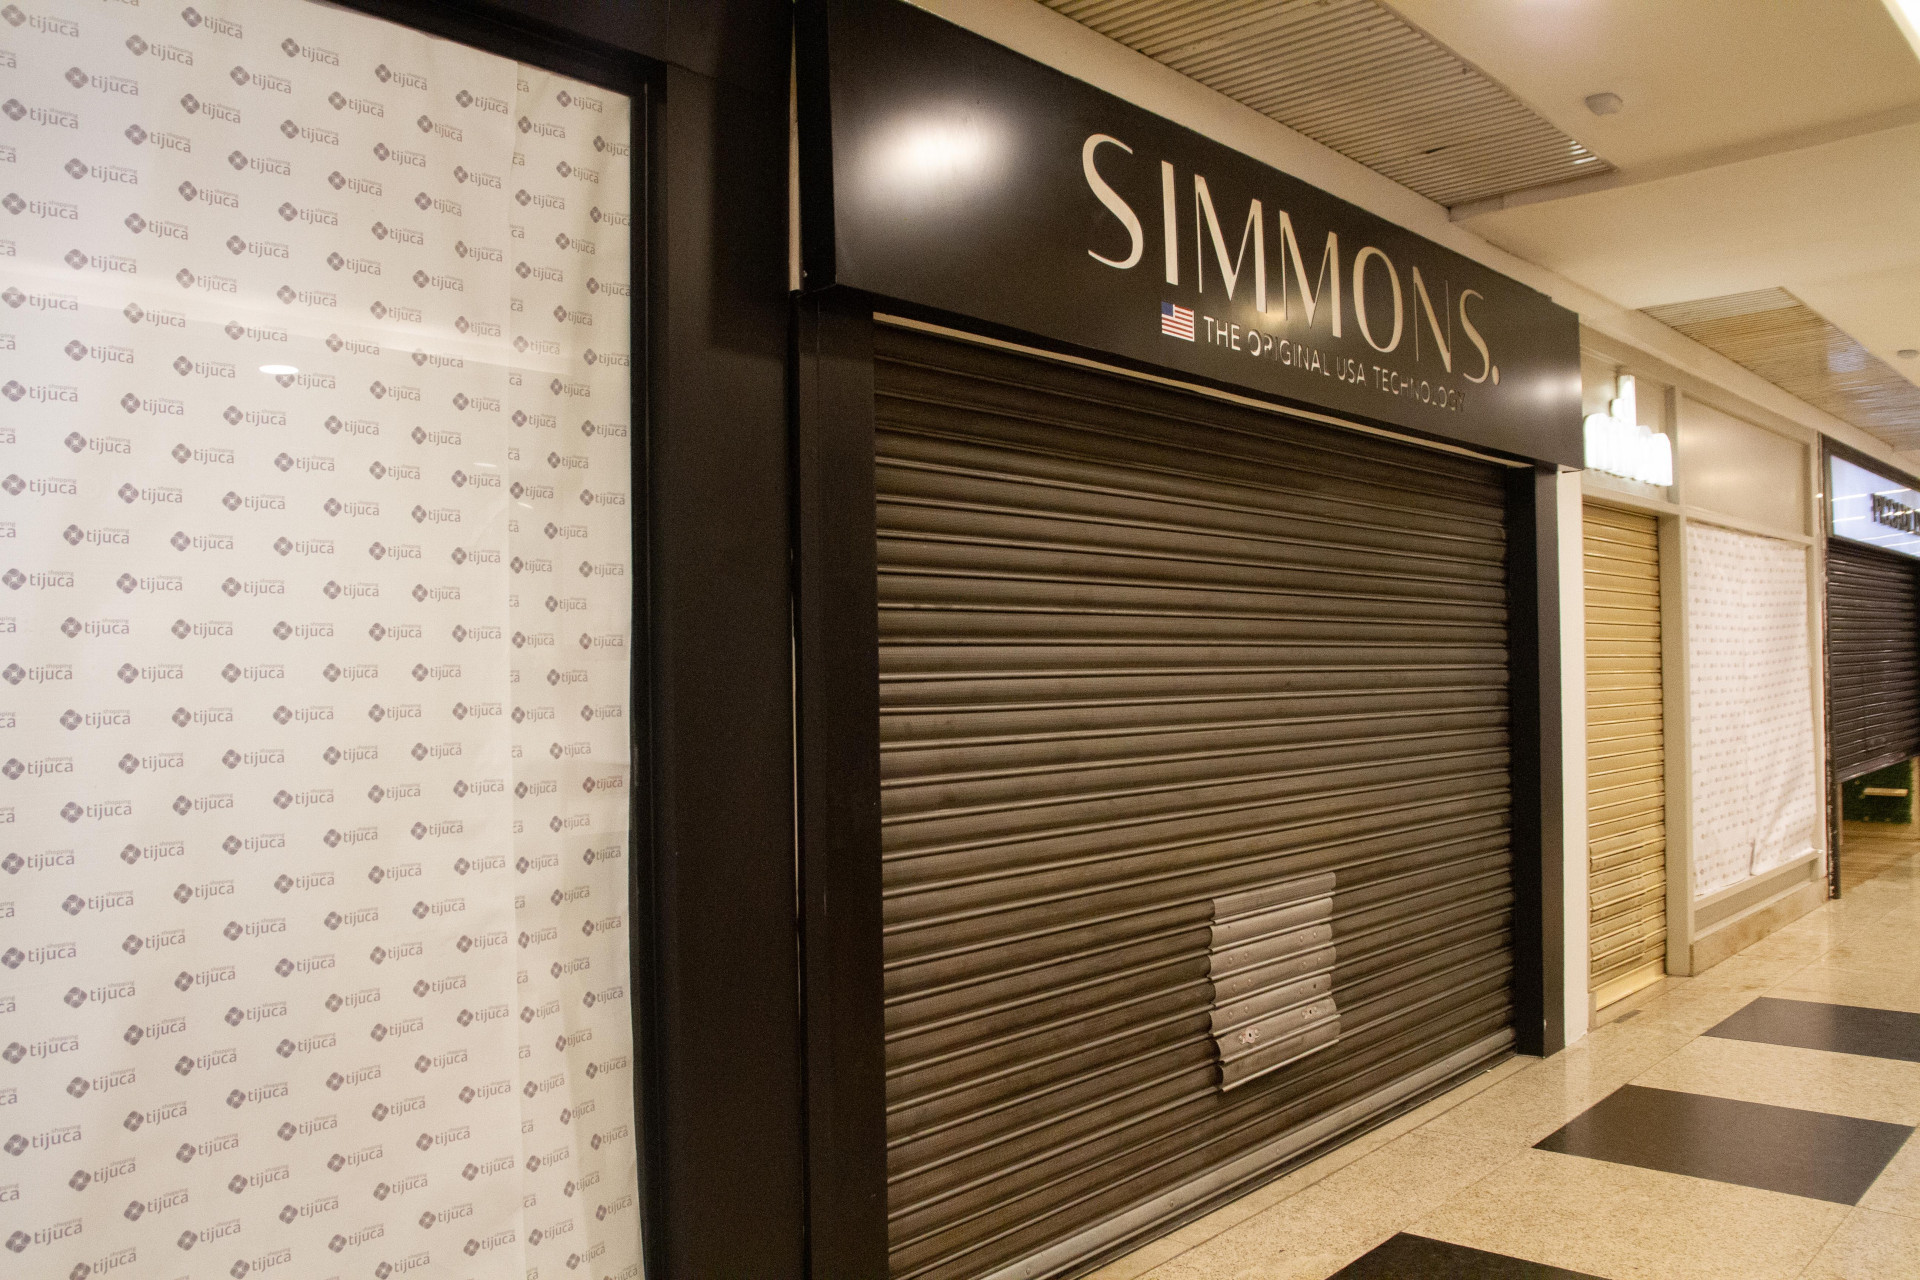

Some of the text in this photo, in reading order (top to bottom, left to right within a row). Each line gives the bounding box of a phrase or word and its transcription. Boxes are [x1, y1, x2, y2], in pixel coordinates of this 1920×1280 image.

[28, 16, 79, 38] tijuca
[204, 19, 243, 38] tijuca
[150, 45, 194, 65] tijuca
[301, 47, 339, 66] tijuca
[90, 76, 139, 96] tijuca
[391, 73, 427, 91] tijuca
[574, 94, 603, 113] tijuca
[28, 109, 78, 129] tijuca
[201, 105, 241, 124] tijuca
[300, 128, 339, 146] tijuca
[433, 125, 462, 141] tijuca
[533, 123, 566, 139] tijuca
[149, 134, 191, 152] tijuca
[90, 165, 138, 185] tijuca
[346, 179, 382, 196] tijuca
[198, 191, 239, 209] tijuca
[432, 201, 462, 216] tijuca
[533, 194, 566, 210] tijuca
[28, 201, 79, 221] tijuca
[148, 222, 189, 240] tijuca
[247, 242, 289, 259] tijuca
[571, 238, 596, 255] tijuca
[90, 255, 137, 273] tijuca
[1082, 134, 1500, 386] SIMMONS.
[533, 266, 564, 282] tijuca
[196, 276, 237, 294] tijuca
[430, 276, 464, 292] tijuca
[28, 293, 78, 311] tijuca
[297, 291, 337, 307] tijuca
[145, 311, 186, 328] tijuca
[245, 326, 288, 343] tijuca
[90, 346, 134, 364] tijuca
[194, 362, 236, 379] tijuca
[1203, 316, 1467, 412] THE ORIGINAL USA TECHNOLOGY
[28, 385, 78, 403] tijuca
[387, 387, 421, 402] tijuca
[142, 399, 184, 416] tijuca
[469, 399, 500, 412] tijuca
[244, 410, 286, 426] tijuca
[88, 438, 131, 455] tijuca
[192, 448, 234, 465] tijuca
[295, 457, 335, 472] tijuca
[387, 466, 421, 481] tijuca
[28, 478, 77, 495] tijuca
[525, 487, 554, 499] tijuca
[141, 488, 183, 504] tijuca
[243, 495, 286, 511] tijuca
[595, 493, 626, 506] tijuca
[85, 529, 130, 546] tijuca
[559, 526, 588, 538] tijuca
[192, 535, 234, 551] tijuca
[294, 540, 335, 555] tijuca
[386, 545, 422, 560] tijuca
[524, 560, 552, 572] tijuca
[594, 564, 624, 577] tijuca
[28, 572, 74, 589] tijuca
[139, 576, 183, 593] tijuca
[243, 580, 285, 596] tijuca
[83, 620, 130, 637] tijuca
[192, 622, 233, 638] tijuca
[294, 623, 334, 639] tijuca
[527, 634, 555, 647] tijuca
[593, 636, 624, 648] tijuca
[27, 666, 73, 683] tijuca
[140, 665, 183, 682] tijuca
[243, 665, 285, 681] tijuca
[342, 666, 379, 681] tijuca
[429, 666, 462, 680] tijuca
[561, 671, 588, 684] tijuca
[84, 711, 131, 728] tijuca
[192, 709, 234, 726] tijuca
[293, 708, 334, 723] tijuca
[526, 708, 555, 722] tijuca
[595, 706, 622, 719] tijuca
[141, 755, 184, 771] tijuca
[242, 751, 285, 767] tijuca
[26, 760, 73, 776] tijuca
[385, 786, 421, 801] tijuca
[468, 781, 504, 795] tijuca
[193, 796, 234, 812] tijuca
[294, 791, 334, 807] tijuca
[85, 803, 132, 820] tijuca
[142, 844, 185, 861] tijuca
[243, 836, 285, 852] tijuca
[26, 853, 75, 870] tijuca
[194, 883, 235, 899] tijuca
[294, 875, 334, 890] tijuca
[87, 895, 134, 911] tijuca
[430, 902, 466, 916] tijuca
[244, 921, 287, 937] tijuca
[144, 933, 186, 950] tijuca
[27, 947, 77, 964] tijuca
[386, 945, 423, 960] tijuca
[194, 969, 236, 986] tijuca
[89, 986, 135, 1003] tijuca
[344, 992, 381, 1007] tijuca
[474, 1008, 509, 1022] tijuca
[145, 1021, 186, 1038] tijuca
[29, 1040, 79, 1058] tijuca
[297, 1037, 336, 1053] tijuca
[195, 1052, 237, 1070] tijuca
[599, 1059, 627, 1074] tijuca
[92, 1073, 136, 1091] tijuca
[476, 1084, 511, 1099] tijuca
[145, 1105, 187, 1124] tijuca
[389, 1099, 426, 1115] tijuca
[298, 1118, 337, 1136] tijuca
[31, 1130, 82, 1150] tijuca
[602, 1128, 629, 1145] tijuca
[197, 1137, 239, 1156] tijuca
[542, 1149, 570, 1168] tijuca
[93, 1162, 136, 1181] tijuca
[391, 1177, 428, 1194] tijuca
[146, 1192, 189, 1212] tijuca
[299, 1198, 339, 1217] tijuca
[33, 1224, 83, 1245] tijuca
[199, 1222, 241, 1242] tijuca
[544, 1222, 574, 1240] tijuca
[93, 1250, 137, 1274] tijuca
[394, 1255, 430, 1273] tijuca
